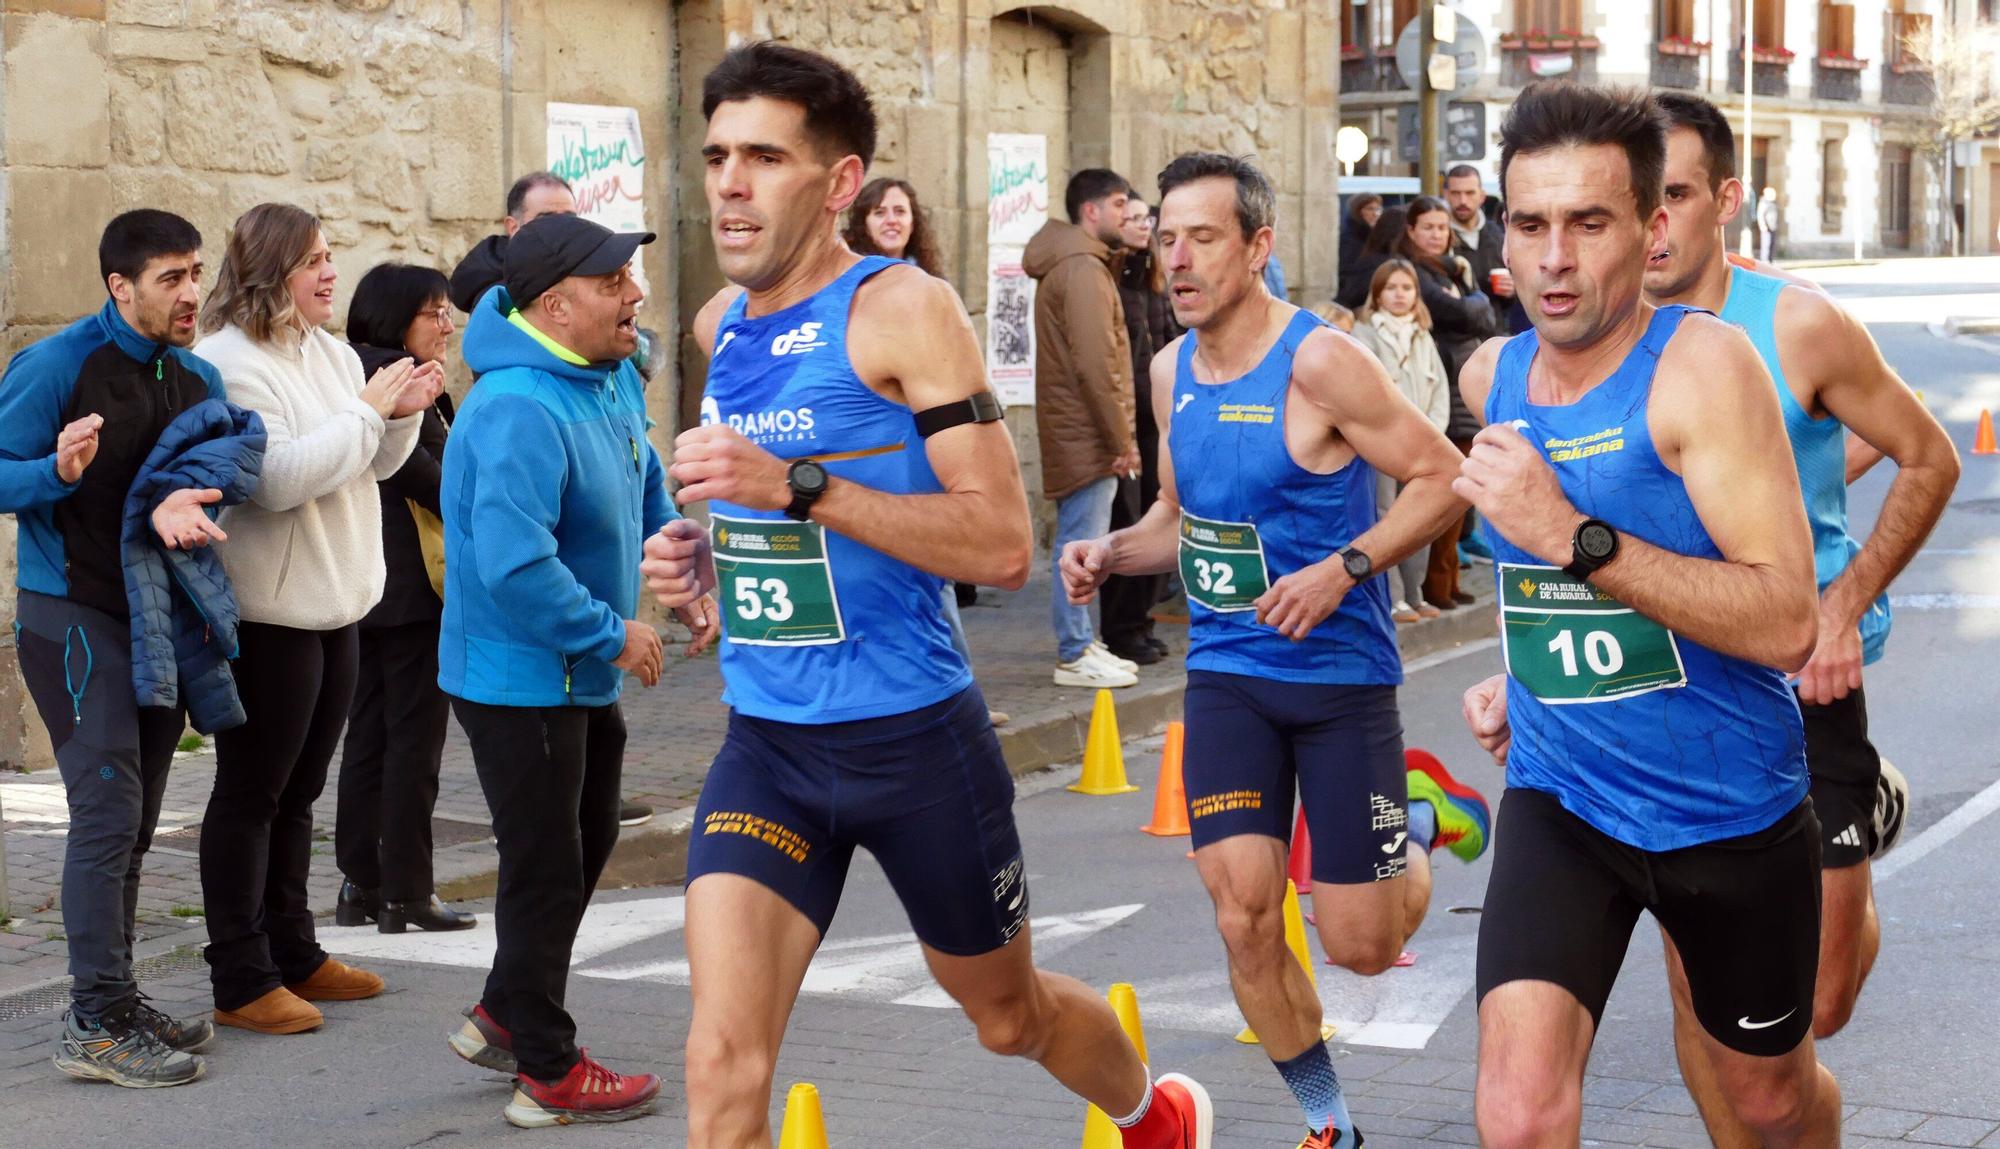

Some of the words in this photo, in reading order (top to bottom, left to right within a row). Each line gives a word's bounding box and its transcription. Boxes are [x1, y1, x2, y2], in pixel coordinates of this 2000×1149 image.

[728, 407, 815, 436] RAMOS
[1218, 411, 1274, 423] sakana
[752, 431, 817, 445] USTRIAL
[1545, 426, 1624, 448] dantzaleku
[1550, 438, 1625, 463] sakana
[1194, 558, 1237, 594] 32
[1539, 582, 1559, 592] CAJA
[1560, 583, 1589, 592] RURAL
[735, 576, 794, 621] 53
[1539, 591, 1552, 600] DE
[1553, 591, 1594, 601] NAVARRA
[1548, 629, 1624, 677] 10
[1191, 790, 1261, 808] dantzaleku
[1194, 799, 1261, 819] sakana
[703, 821, 807, 864] sakana
[704, 811, 811, 852] dantzaleku
